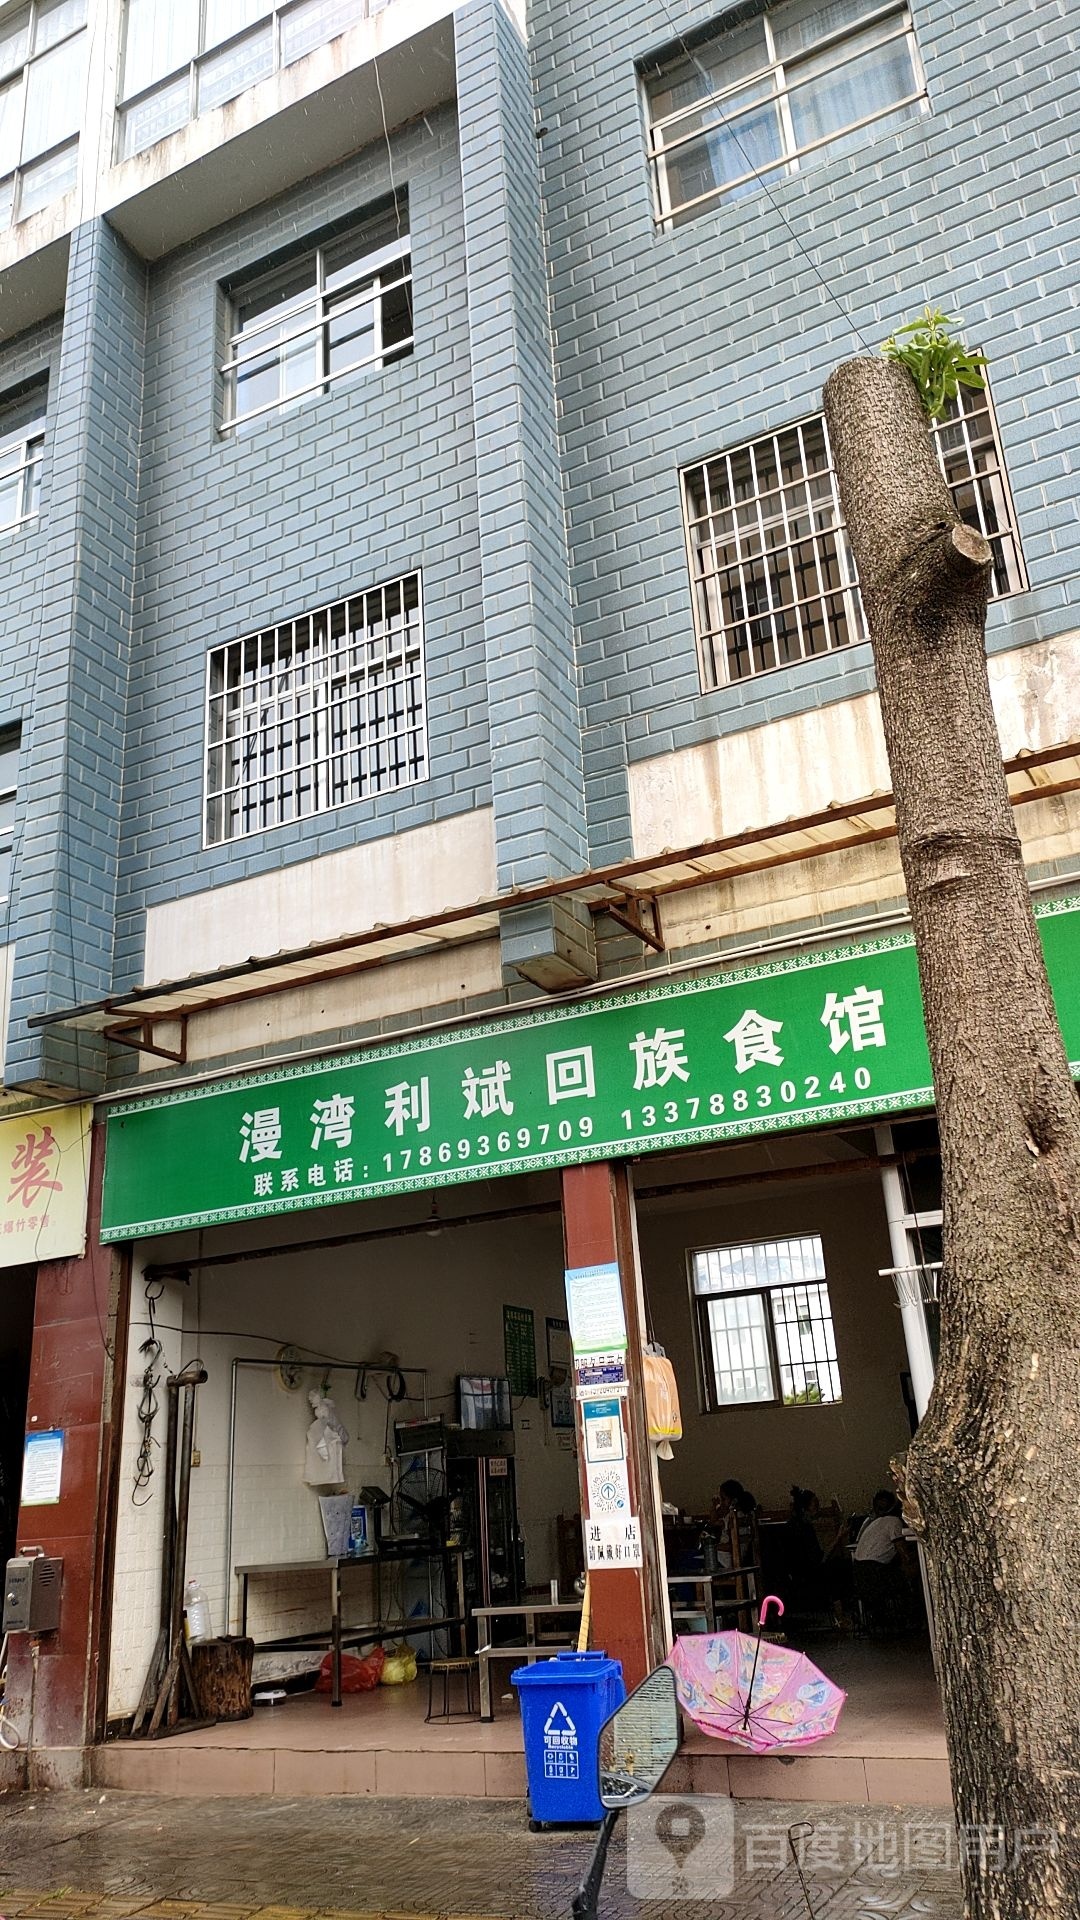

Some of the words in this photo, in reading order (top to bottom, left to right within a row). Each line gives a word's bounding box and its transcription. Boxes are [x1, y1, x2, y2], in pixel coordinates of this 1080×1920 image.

[238, 985, 887, 1163] 漫湾利斌回族食馆
[621, 1067, 872, 1130] 13378830240
[7, 1126, 63, 1208] 装
[544, 1735, 578, 1746] 可回收物
